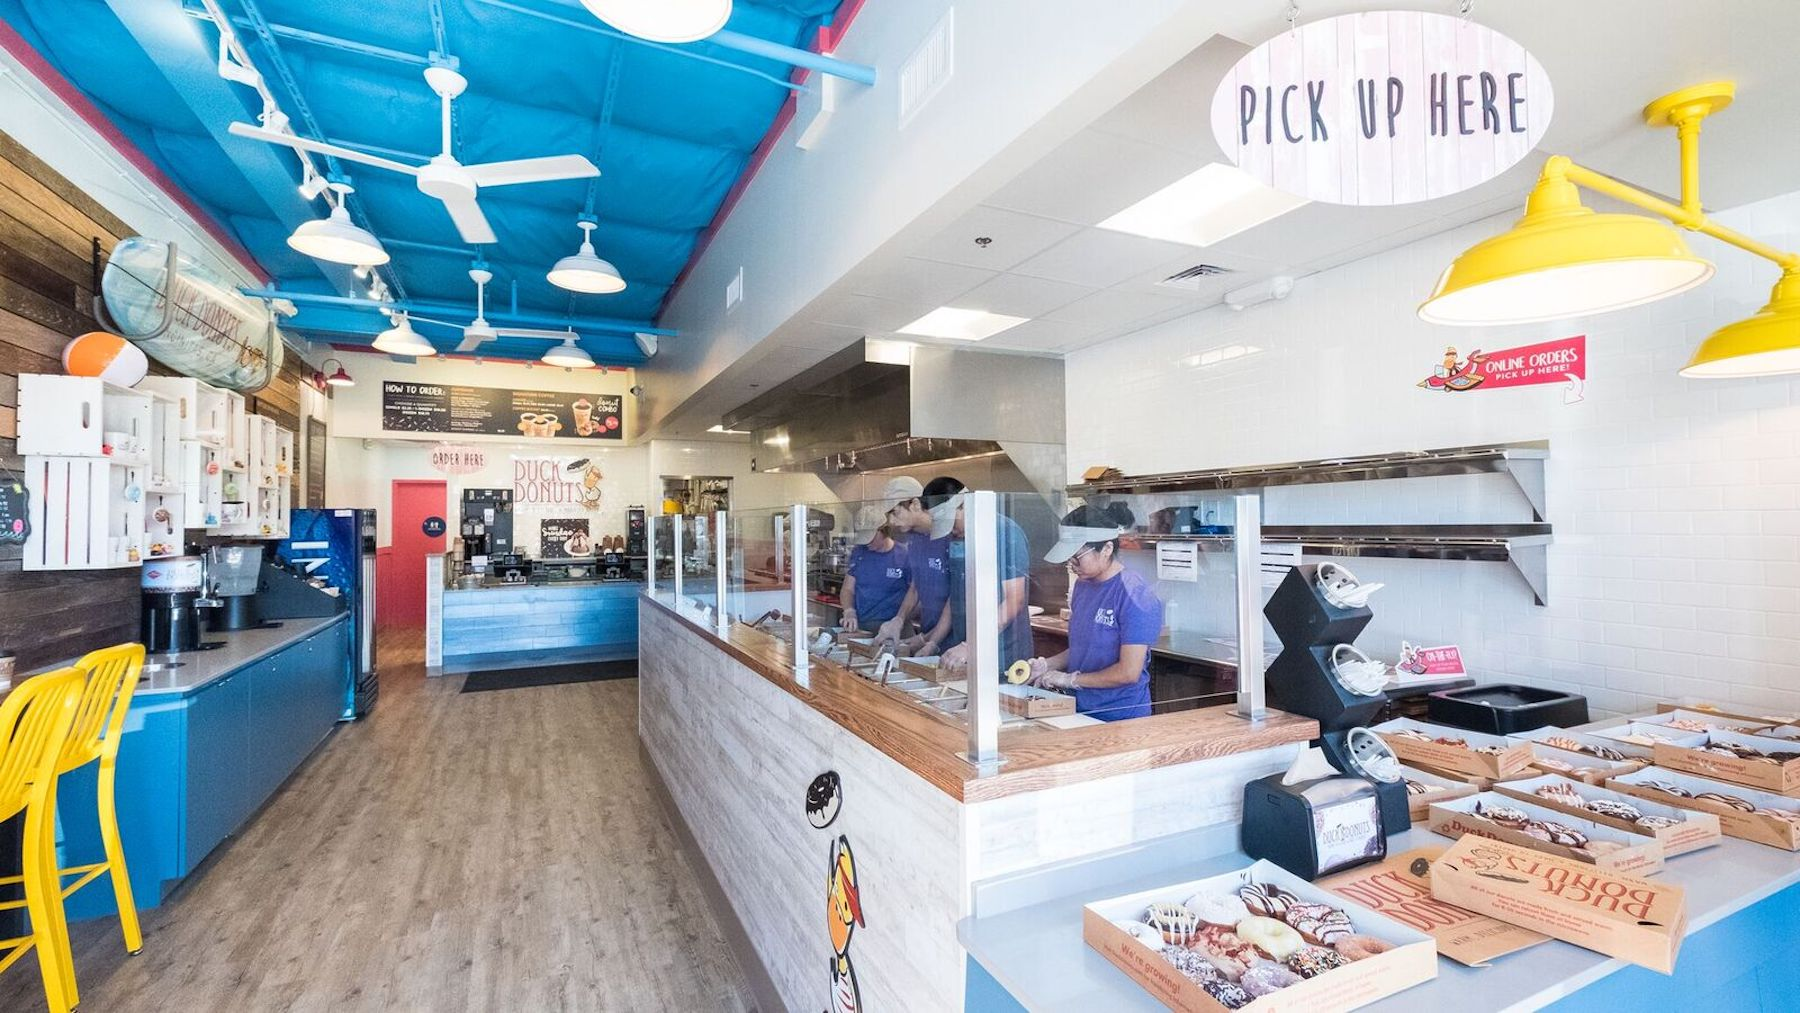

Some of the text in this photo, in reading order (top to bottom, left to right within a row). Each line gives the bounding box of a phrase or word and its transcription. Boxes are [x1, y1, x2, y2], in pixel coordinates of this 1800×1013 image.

[1240, 71, 1527, 146] PICK UP HERE
[1485, 348, 1578, 374] ONLINE ORDERS
[1495, 363, 1571, 381] PICK UP HERE!
[385, 384, 404, 393] HOW
[406, 385, 417, 394] TO
[432, 452, 485, 467] ORDER HERE
[514, 459, 562, 482] DUCK
[514, 481, 584, 503] DONUTS
[1333, 871, 1434, 909] DUCK
[1505, 855, 1657, 906] DONUTS
[1540, 880, 1652, 920] DUCK
[1122, 941, 1146, 970] We're
[1148, 961, 1181, 997] growing!
